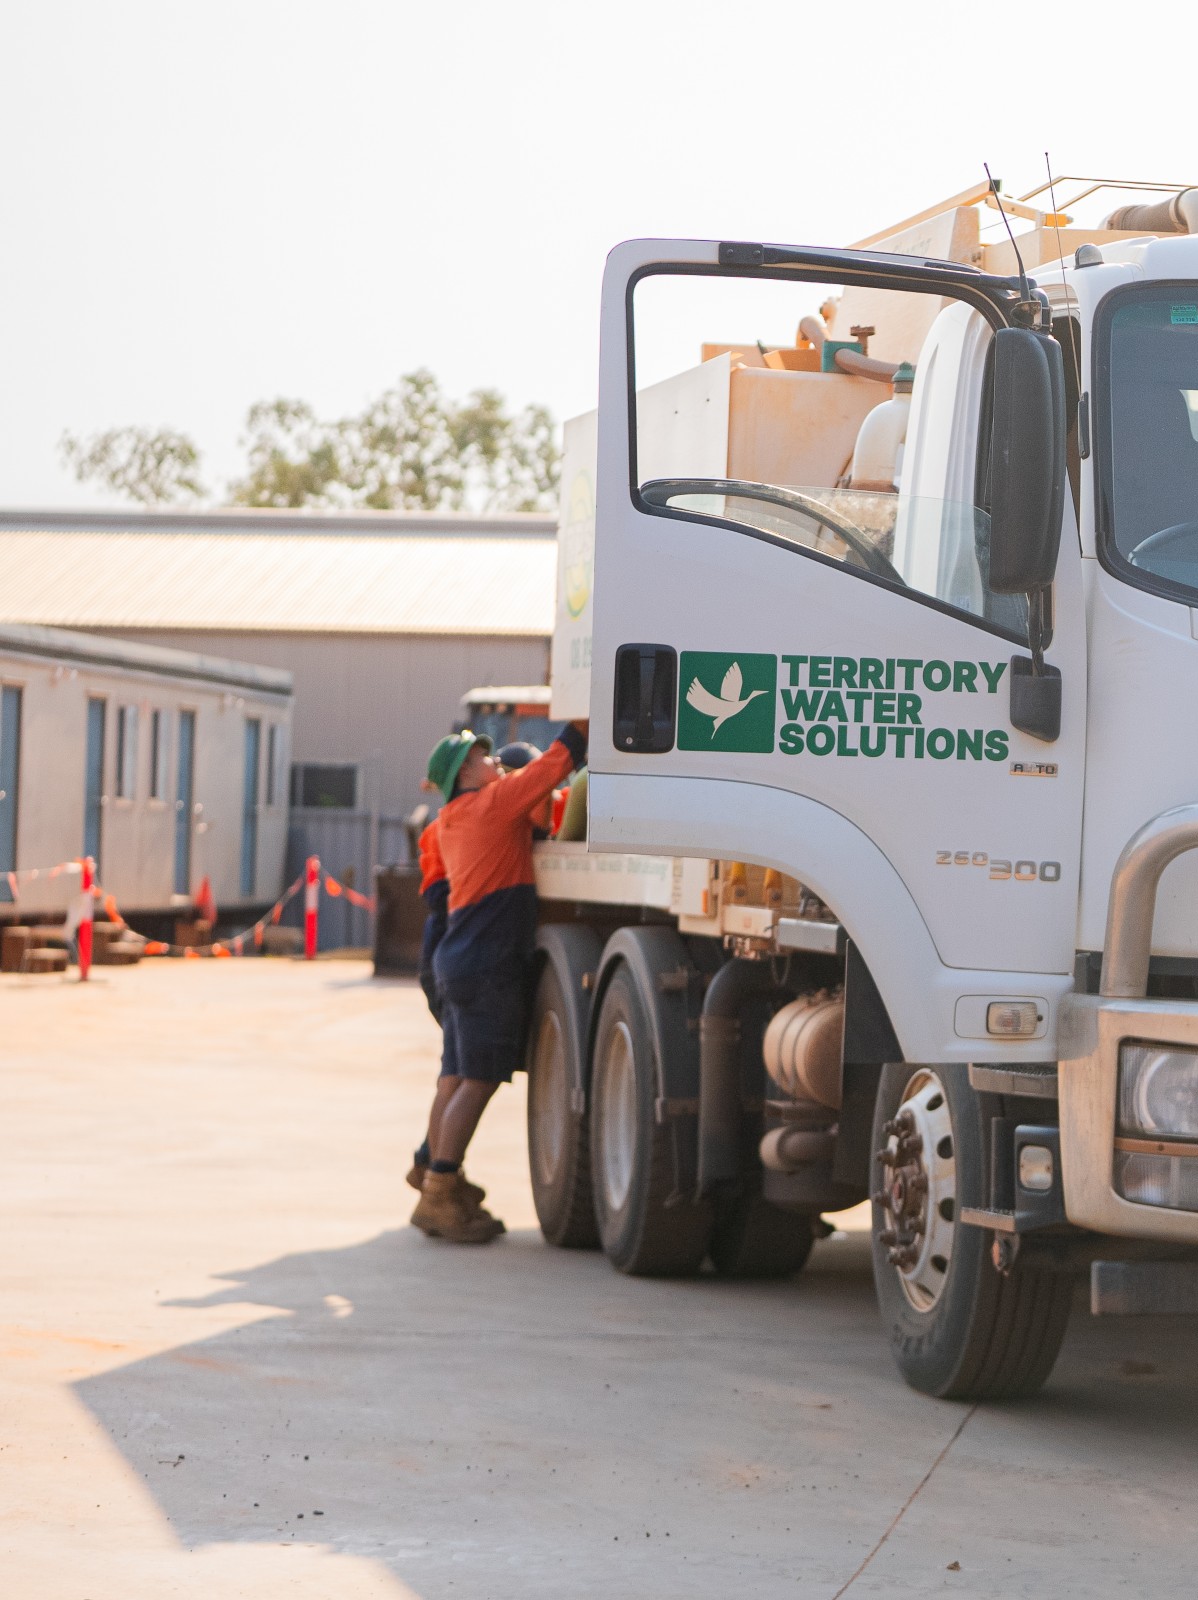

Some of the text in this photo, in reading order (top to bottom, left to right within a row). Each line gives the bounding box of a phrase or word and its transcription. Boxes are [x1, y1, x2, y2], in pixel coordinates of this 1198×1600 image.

[781, 654, 1008, 694] TERRITORY
[780, 689, 922, 725] WATER
[779, 722, 1009, 762] SOLUTIONS
[1013, 762, 1056, 775] ATO
[935, 850, 1062, 882] 260 300
